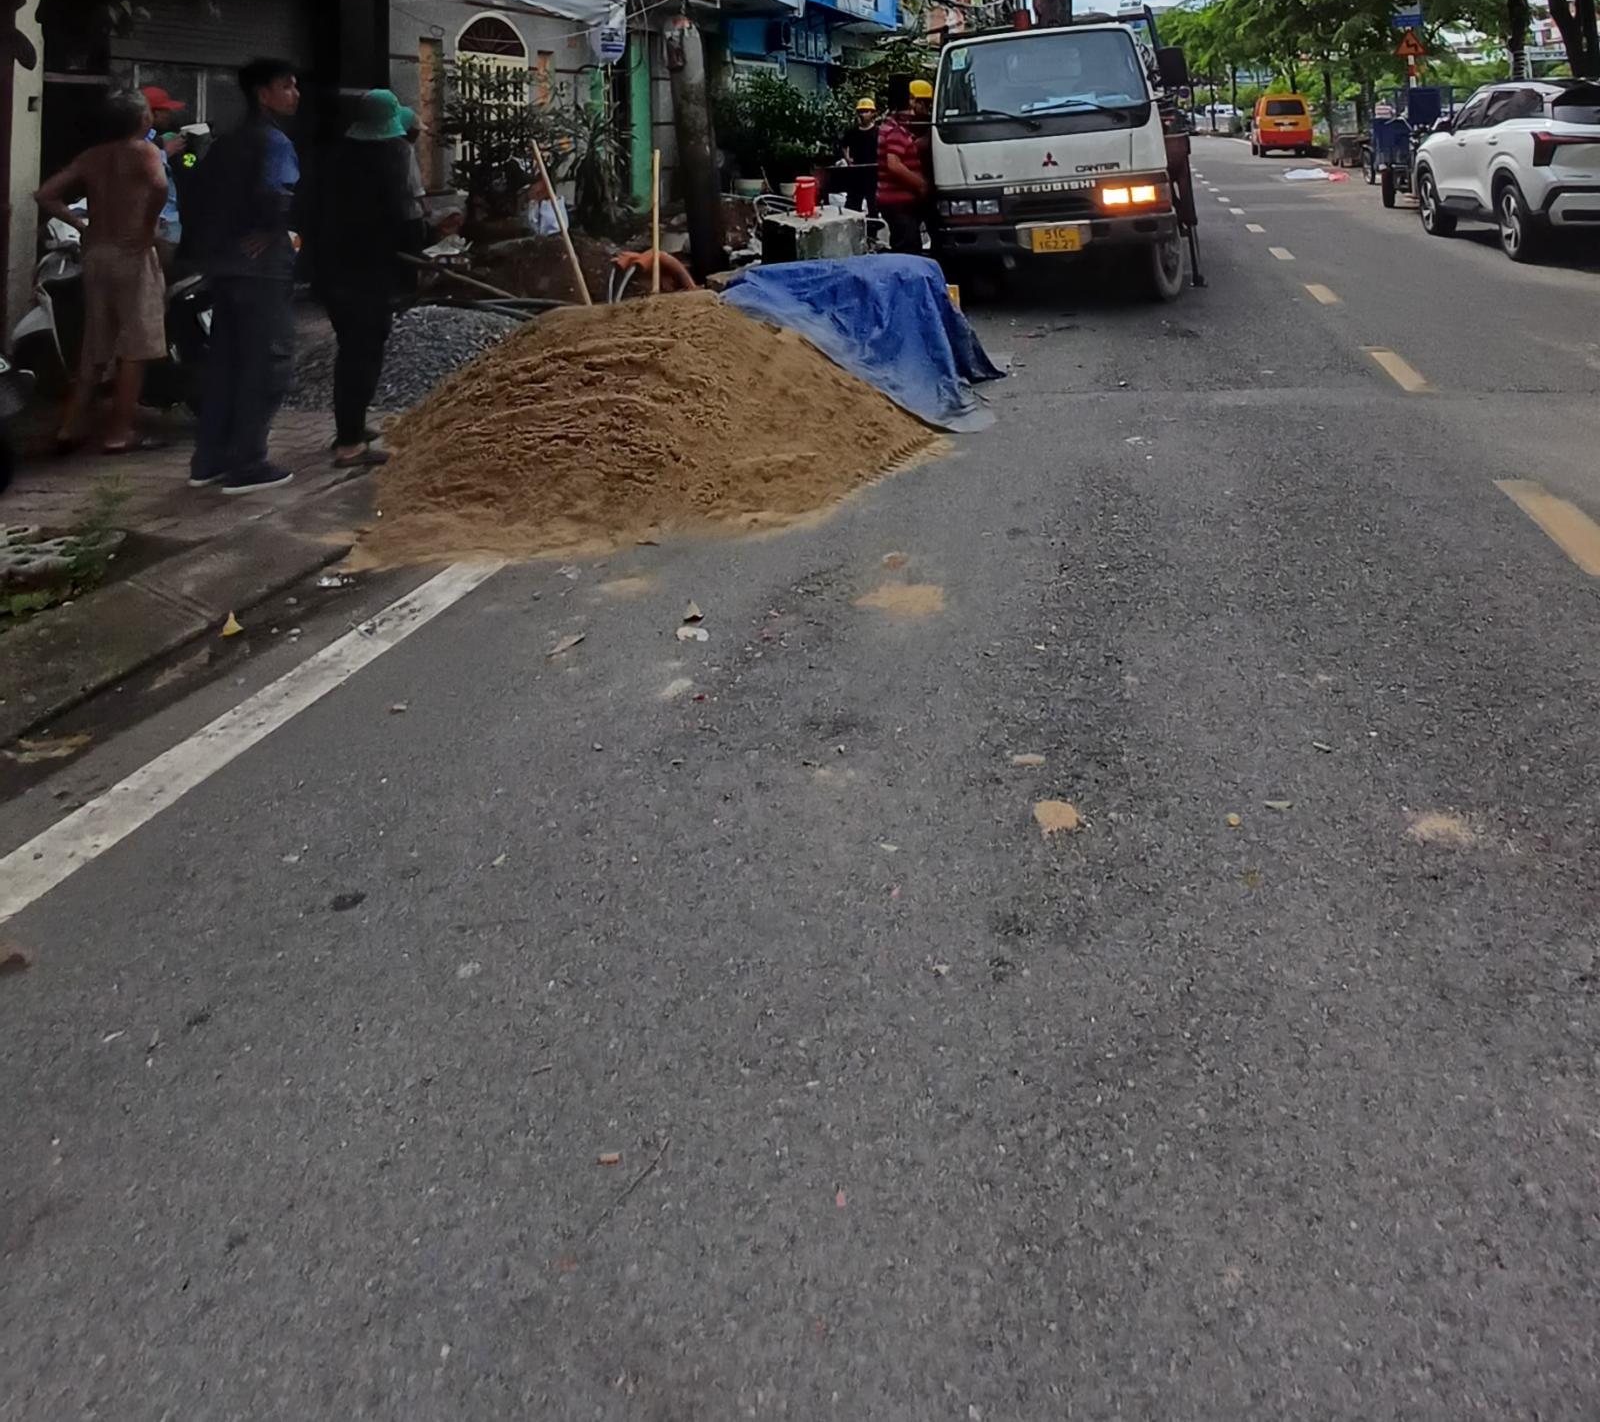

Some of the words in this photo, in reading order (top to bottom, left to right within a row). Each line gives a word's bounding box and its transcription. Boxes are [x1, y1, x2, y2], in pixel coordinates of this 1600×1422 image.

[1075, 162, 1120, 173] CANTER
[1003, 179, 1097, 195] MITSUBISHI
[1044, 228, 1066, 239] 51C
